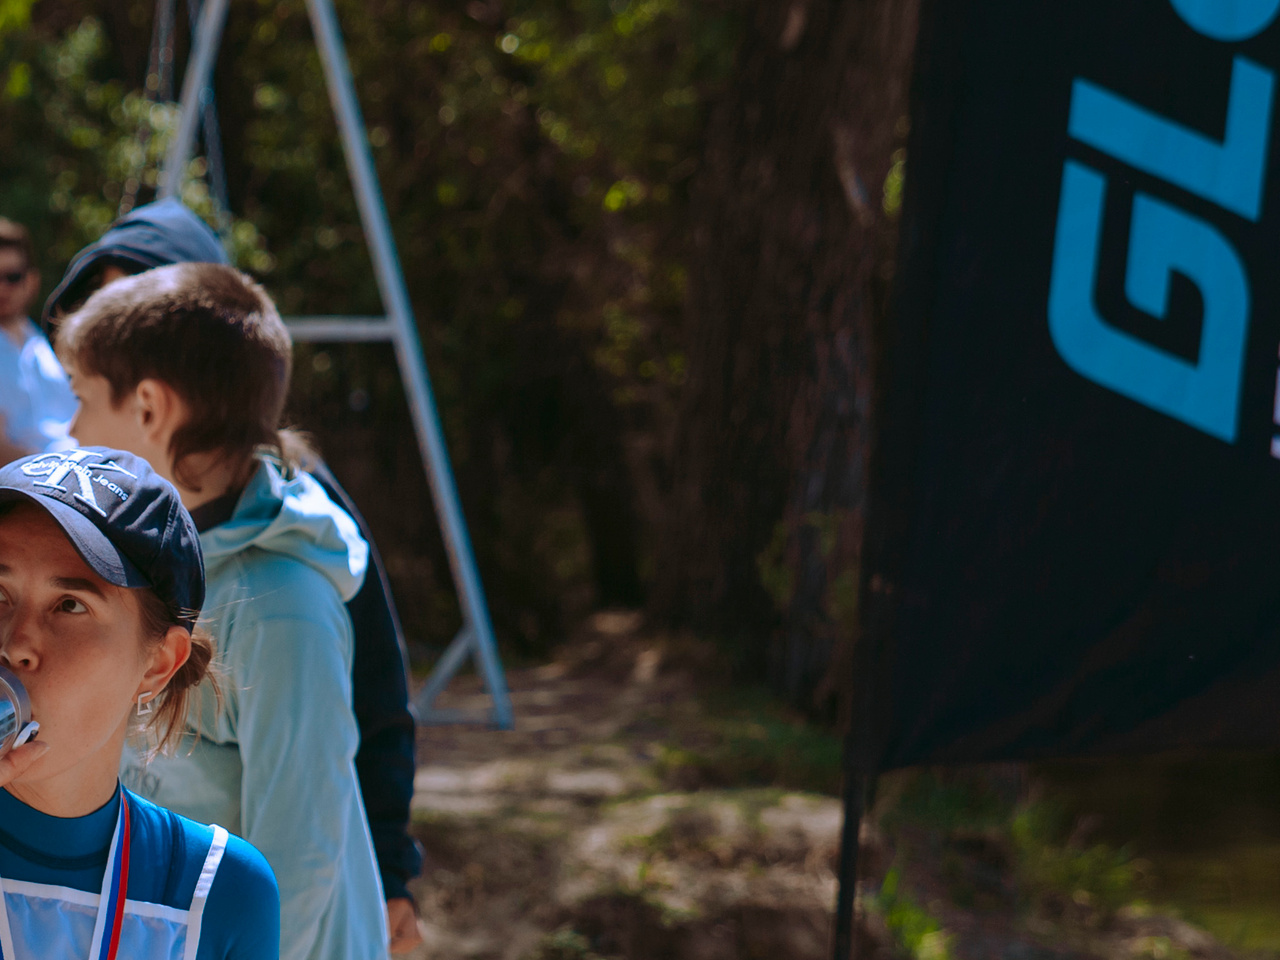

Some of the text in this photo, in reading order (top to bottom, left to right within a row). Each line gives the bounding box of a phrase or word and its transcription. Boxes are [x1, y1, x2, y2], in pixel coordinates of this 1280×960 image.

[1047, 0, 1280, 445] GL
[61, 459, 93, 478] Klein
[92, 473, 129, 501] Jeans
